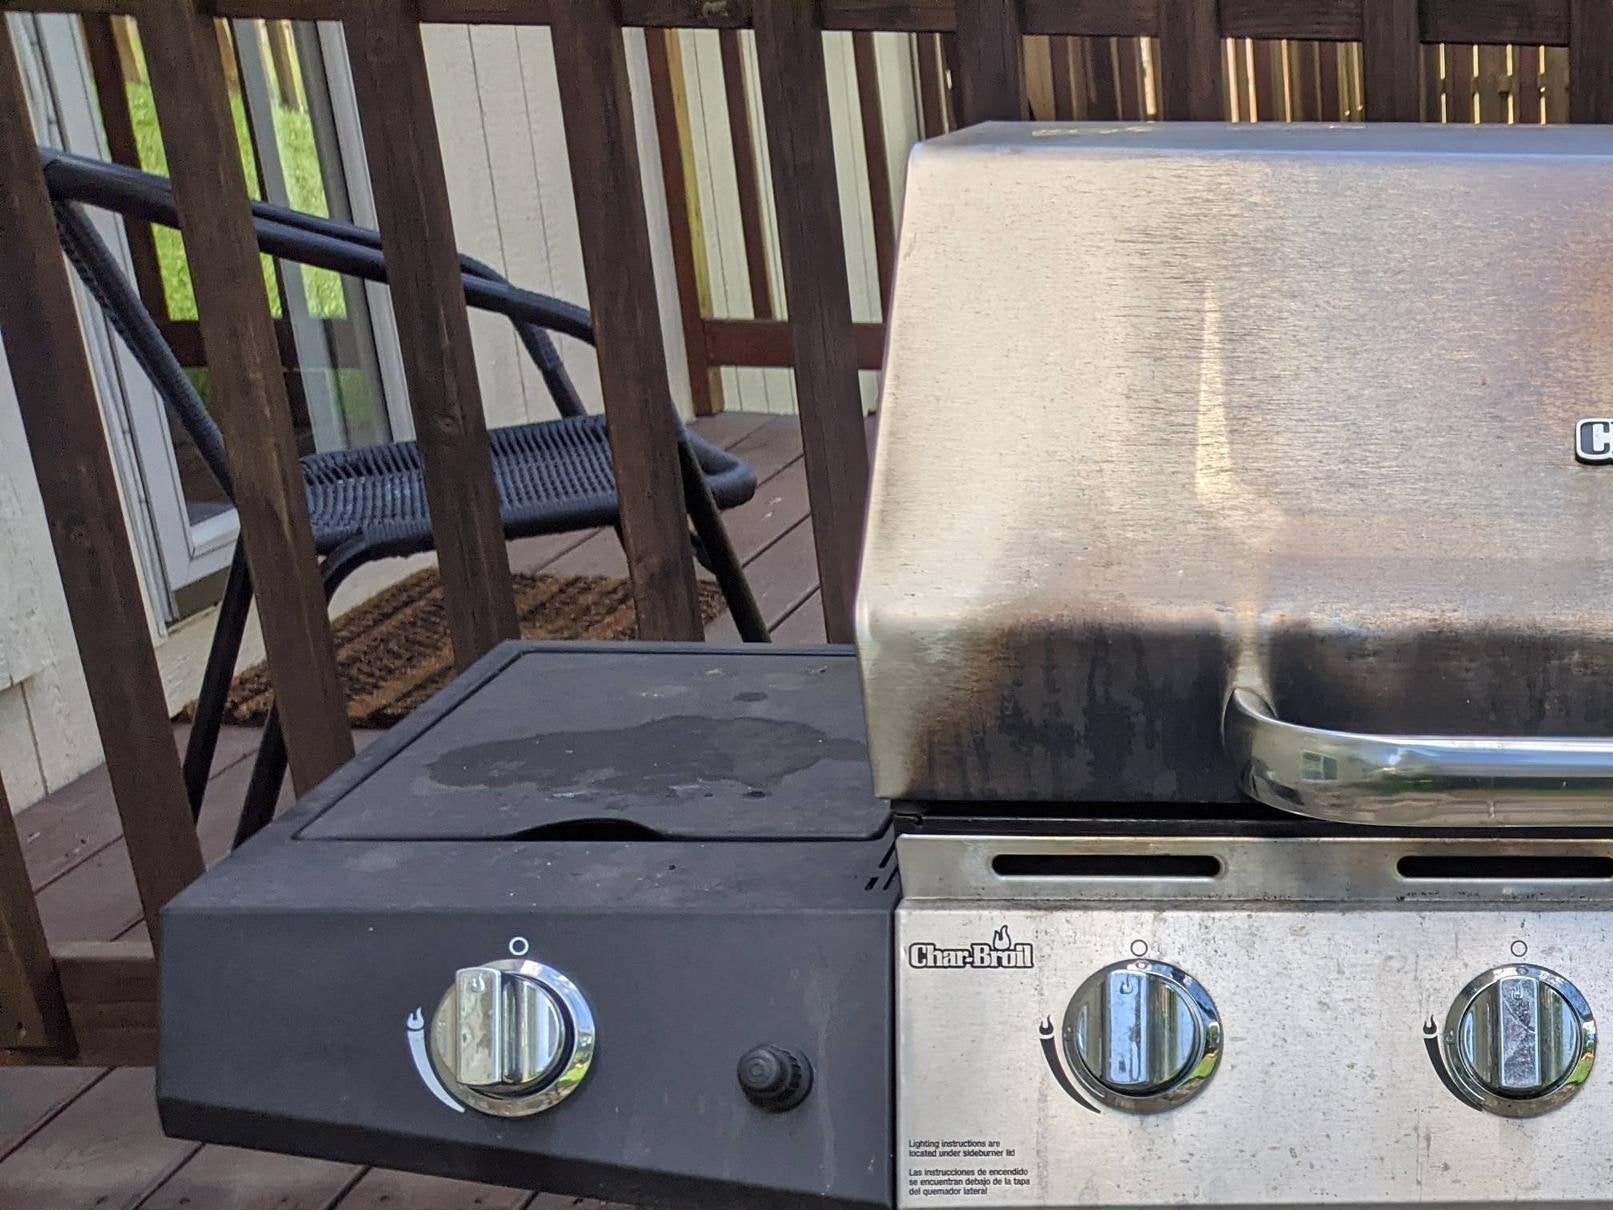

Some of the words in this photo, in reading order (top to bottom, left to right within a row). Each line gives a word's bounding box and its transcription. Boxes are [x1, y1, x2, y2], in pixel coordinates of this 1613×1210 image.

[910, 943, 1034, 968] Char-Broil
[909, 1140, 940, 1148] Lighting
[942, 1140, 986, 1148] instructions
[978, 1168, 987, 1176] de
[989, 1168, 1028, 1176] encendido
[923, 1188, 961, 1196] quemador
